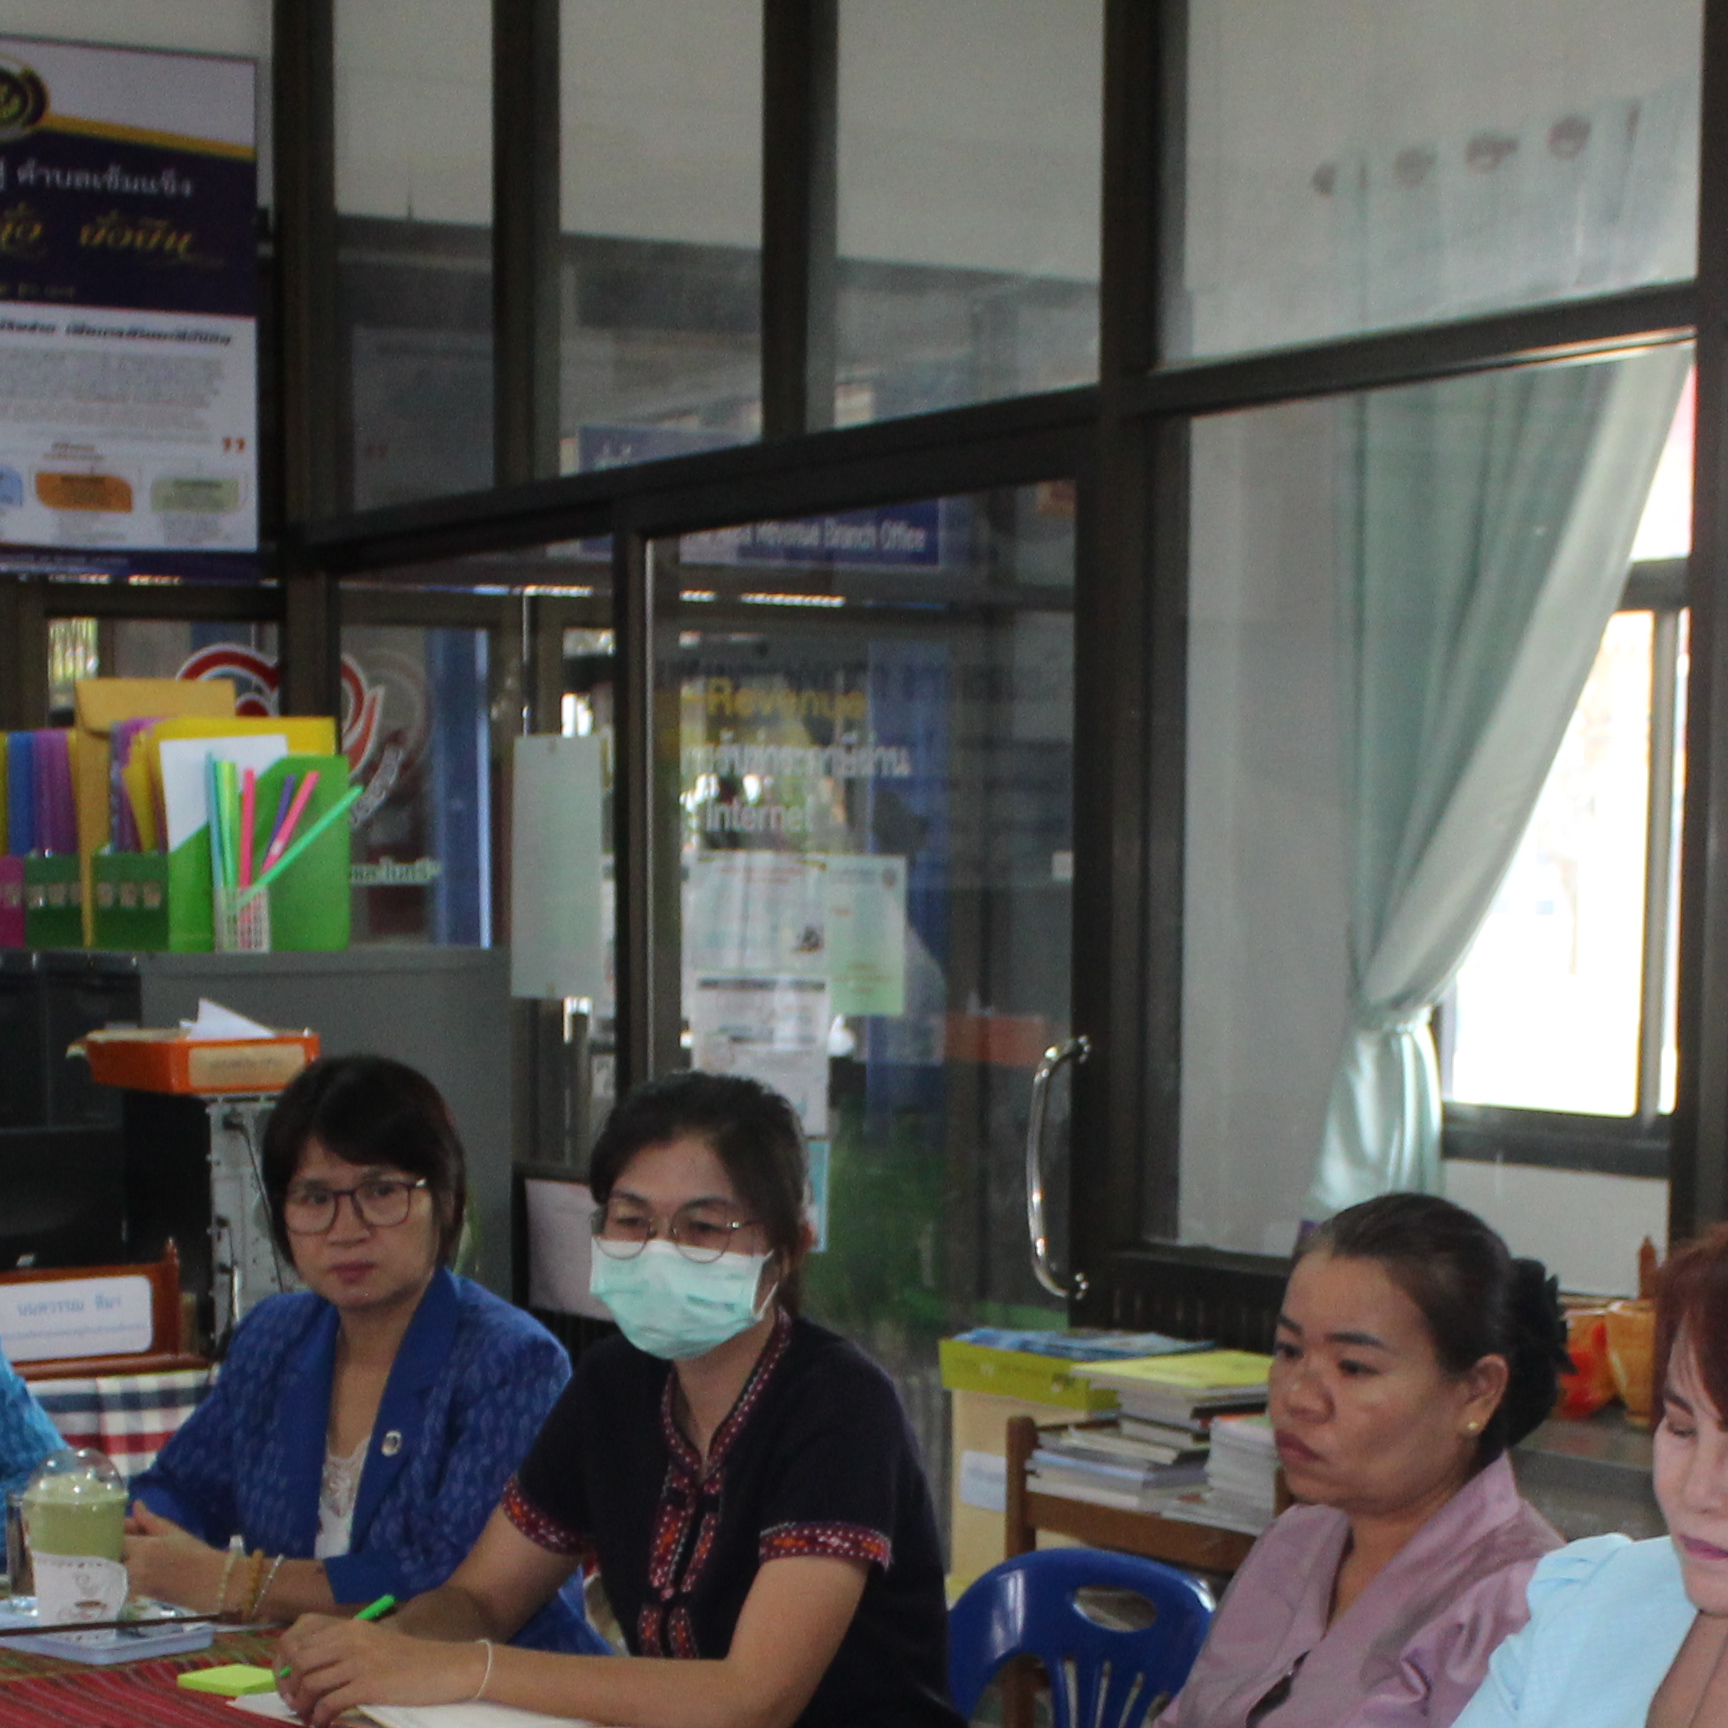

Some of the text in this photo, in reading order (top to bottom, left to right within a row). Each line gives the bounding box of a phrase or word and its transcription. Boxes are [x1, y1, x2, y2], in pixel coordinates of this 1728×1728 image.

[16, 157, 193, 197] ตำบลเข้มแข็ง
[880, 518, 926, 551] Office
